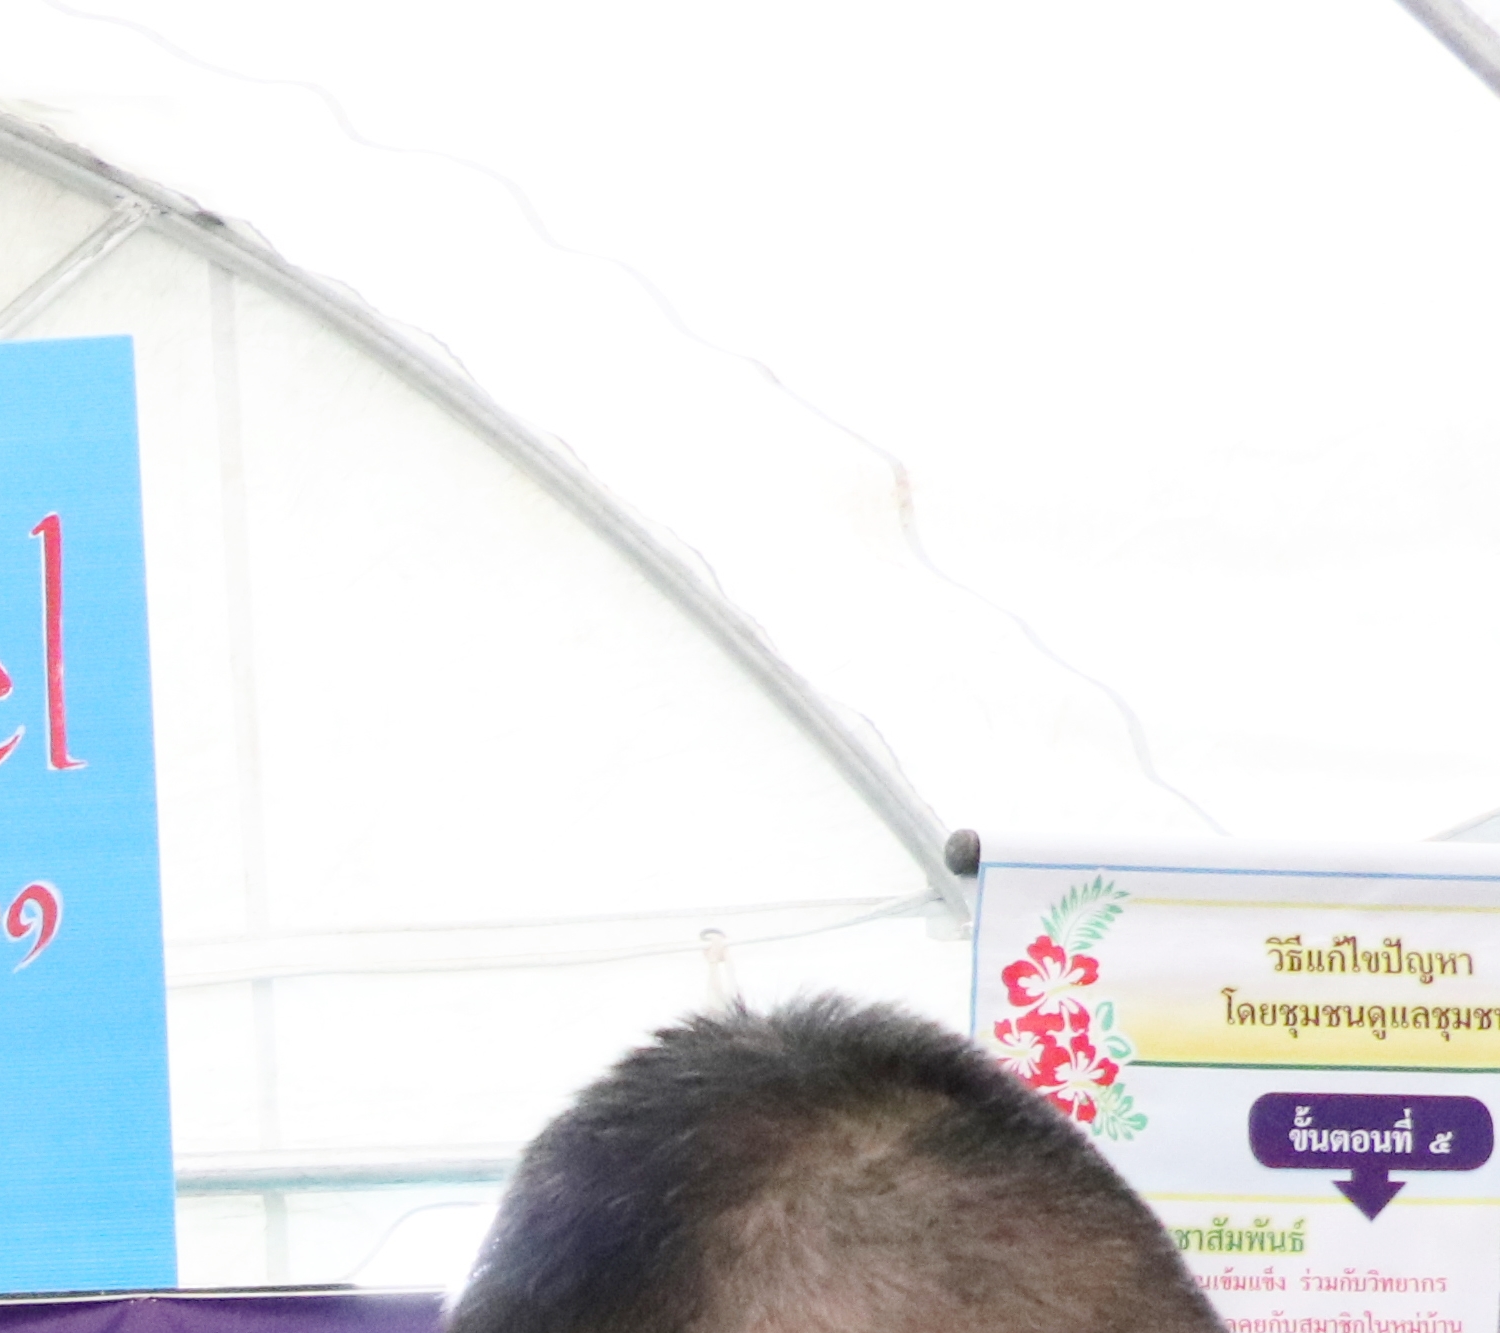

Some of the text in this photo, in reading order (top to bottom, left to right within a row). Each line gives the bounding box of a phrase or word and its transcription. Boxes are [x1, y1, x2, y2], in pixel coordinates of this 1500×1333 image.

[1266, 934, 1474, 984] วิธีแก้ไขปัญหา
[1221, 987, 1500, 1042] โดยชุมชนดูแลชุมช
[1288, 1104, 1453, 1156] ขั้นตอนที่ ๕
[1174, 1217, 1306, 1253] ชาสัมพันธ์
[1198, 1266, 1448, 1294] นเข้มแข็ง ร่วมกับวิทยากร
